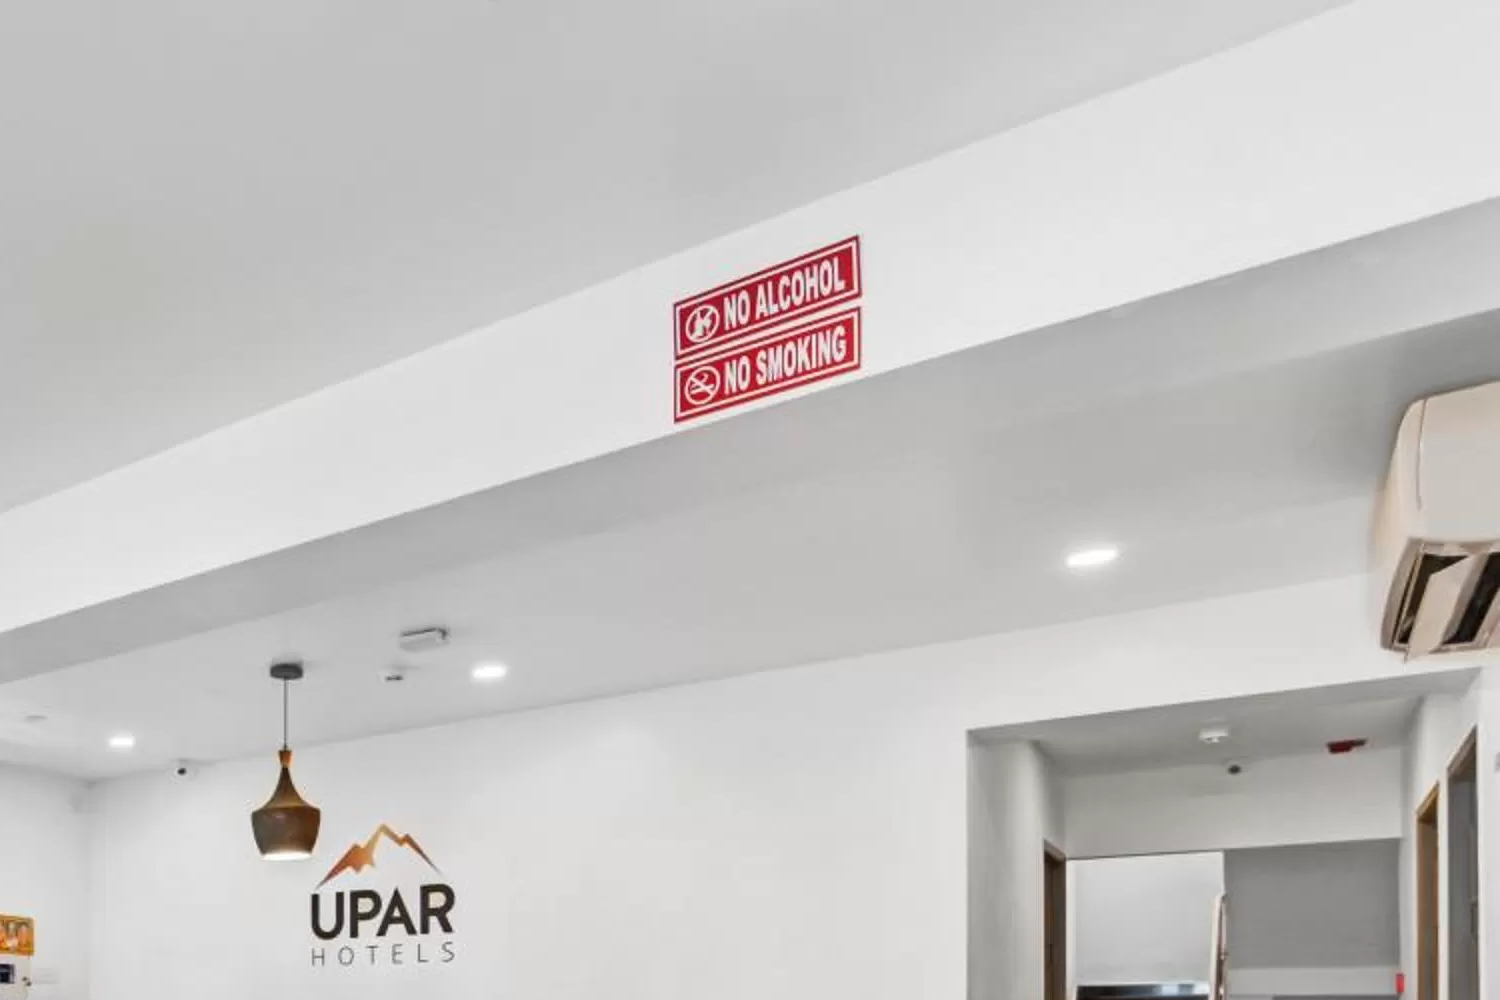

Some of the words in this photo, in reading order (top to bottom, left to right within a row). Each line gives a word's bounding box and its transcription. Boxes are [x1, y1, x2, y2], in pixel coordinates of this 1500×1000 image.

[723, 290, 750, 331] NO
[755, 256, 846, 320] ALCOHOL
[724, 355, 750, 395] NO
[755, 325, 847, 385] SMOKING
[311, 883, 456, 941] UPAR
[311, 941, 456, 967] HOTELS
